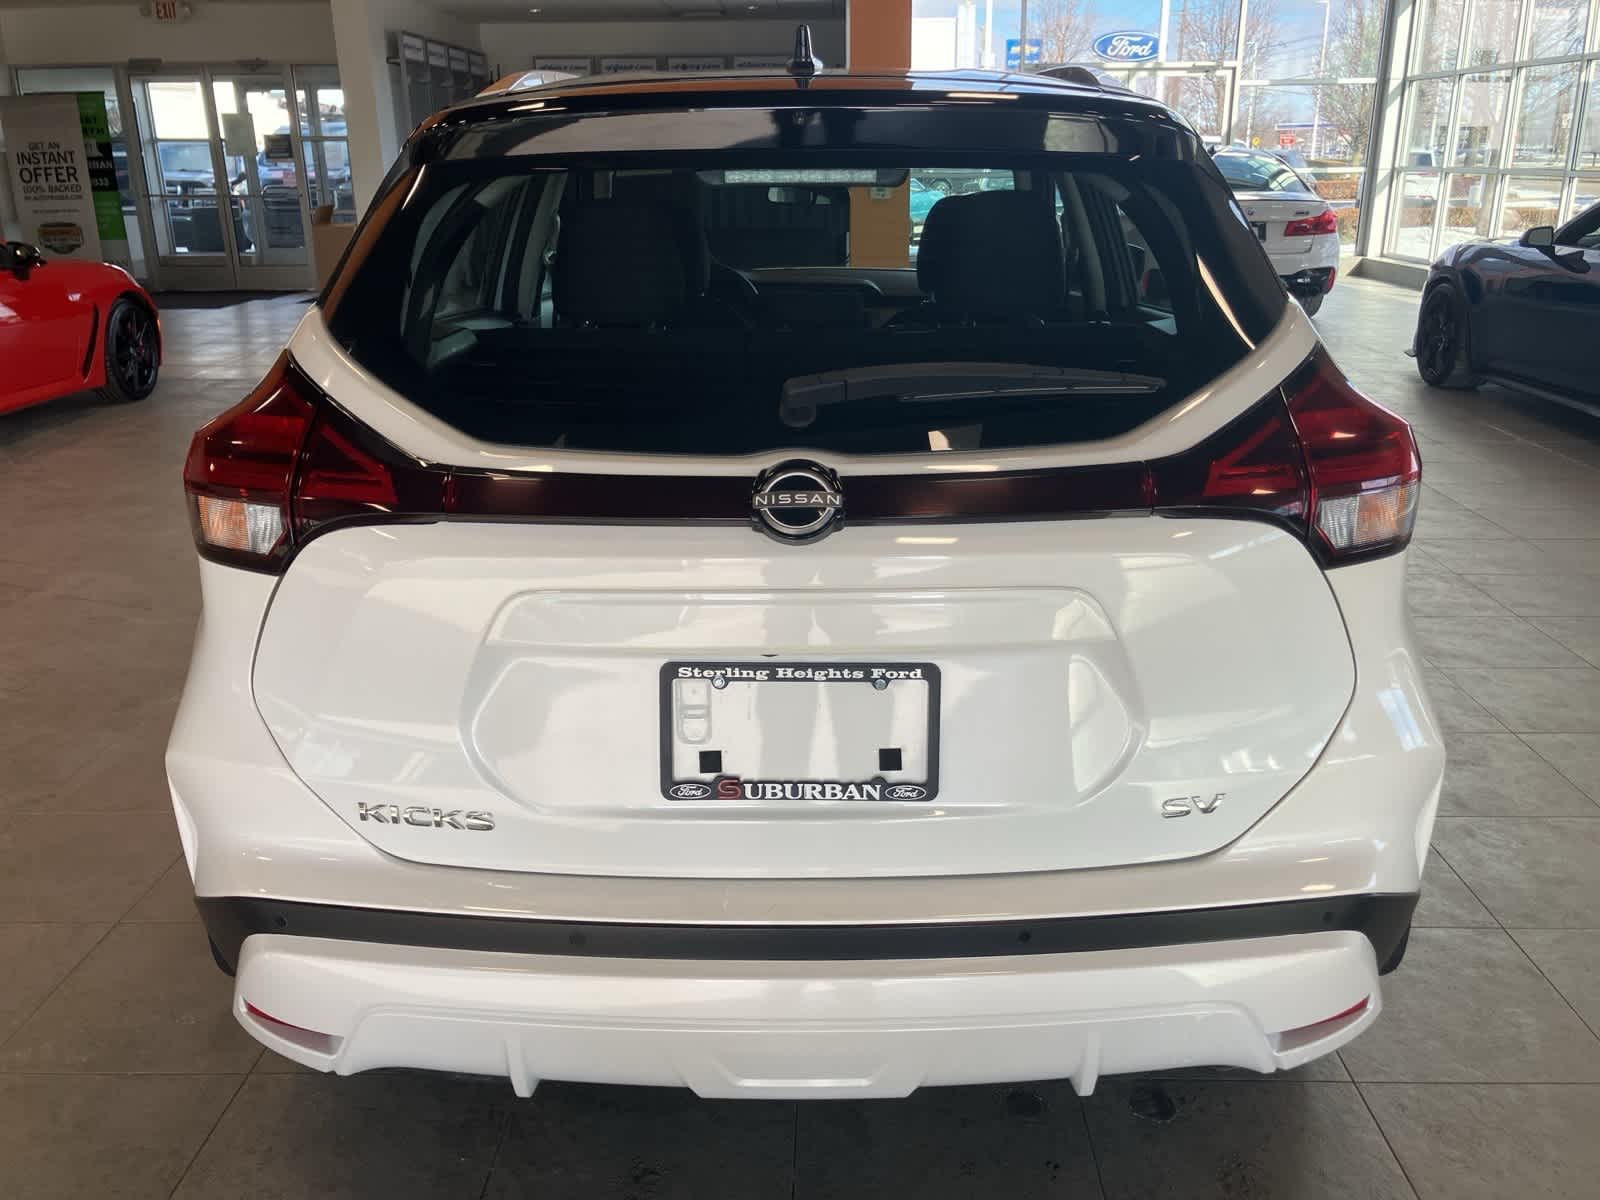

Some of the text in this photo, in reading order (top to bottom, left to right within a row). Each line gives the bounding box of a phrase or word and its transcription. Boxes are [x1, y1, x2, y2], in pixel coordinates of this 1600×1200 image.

[155, 0, 177, 19] EXIT
[1107, 35, 1153, 57] Ford
[17, 151, 75, 165] INSTANT
[19, 166, 79, 183] OFFER
[48, 184, 82, 193] BACKED
[755, 494, 840, 505] NISSAN
[678, 667, 923, 681] Sterling Heights Ford
[677, 778, 919, 800] Ford SUBURBAN Ford
[1161, 792, 1226, 819] SV
[358, 802, 495, 831] KICKS
